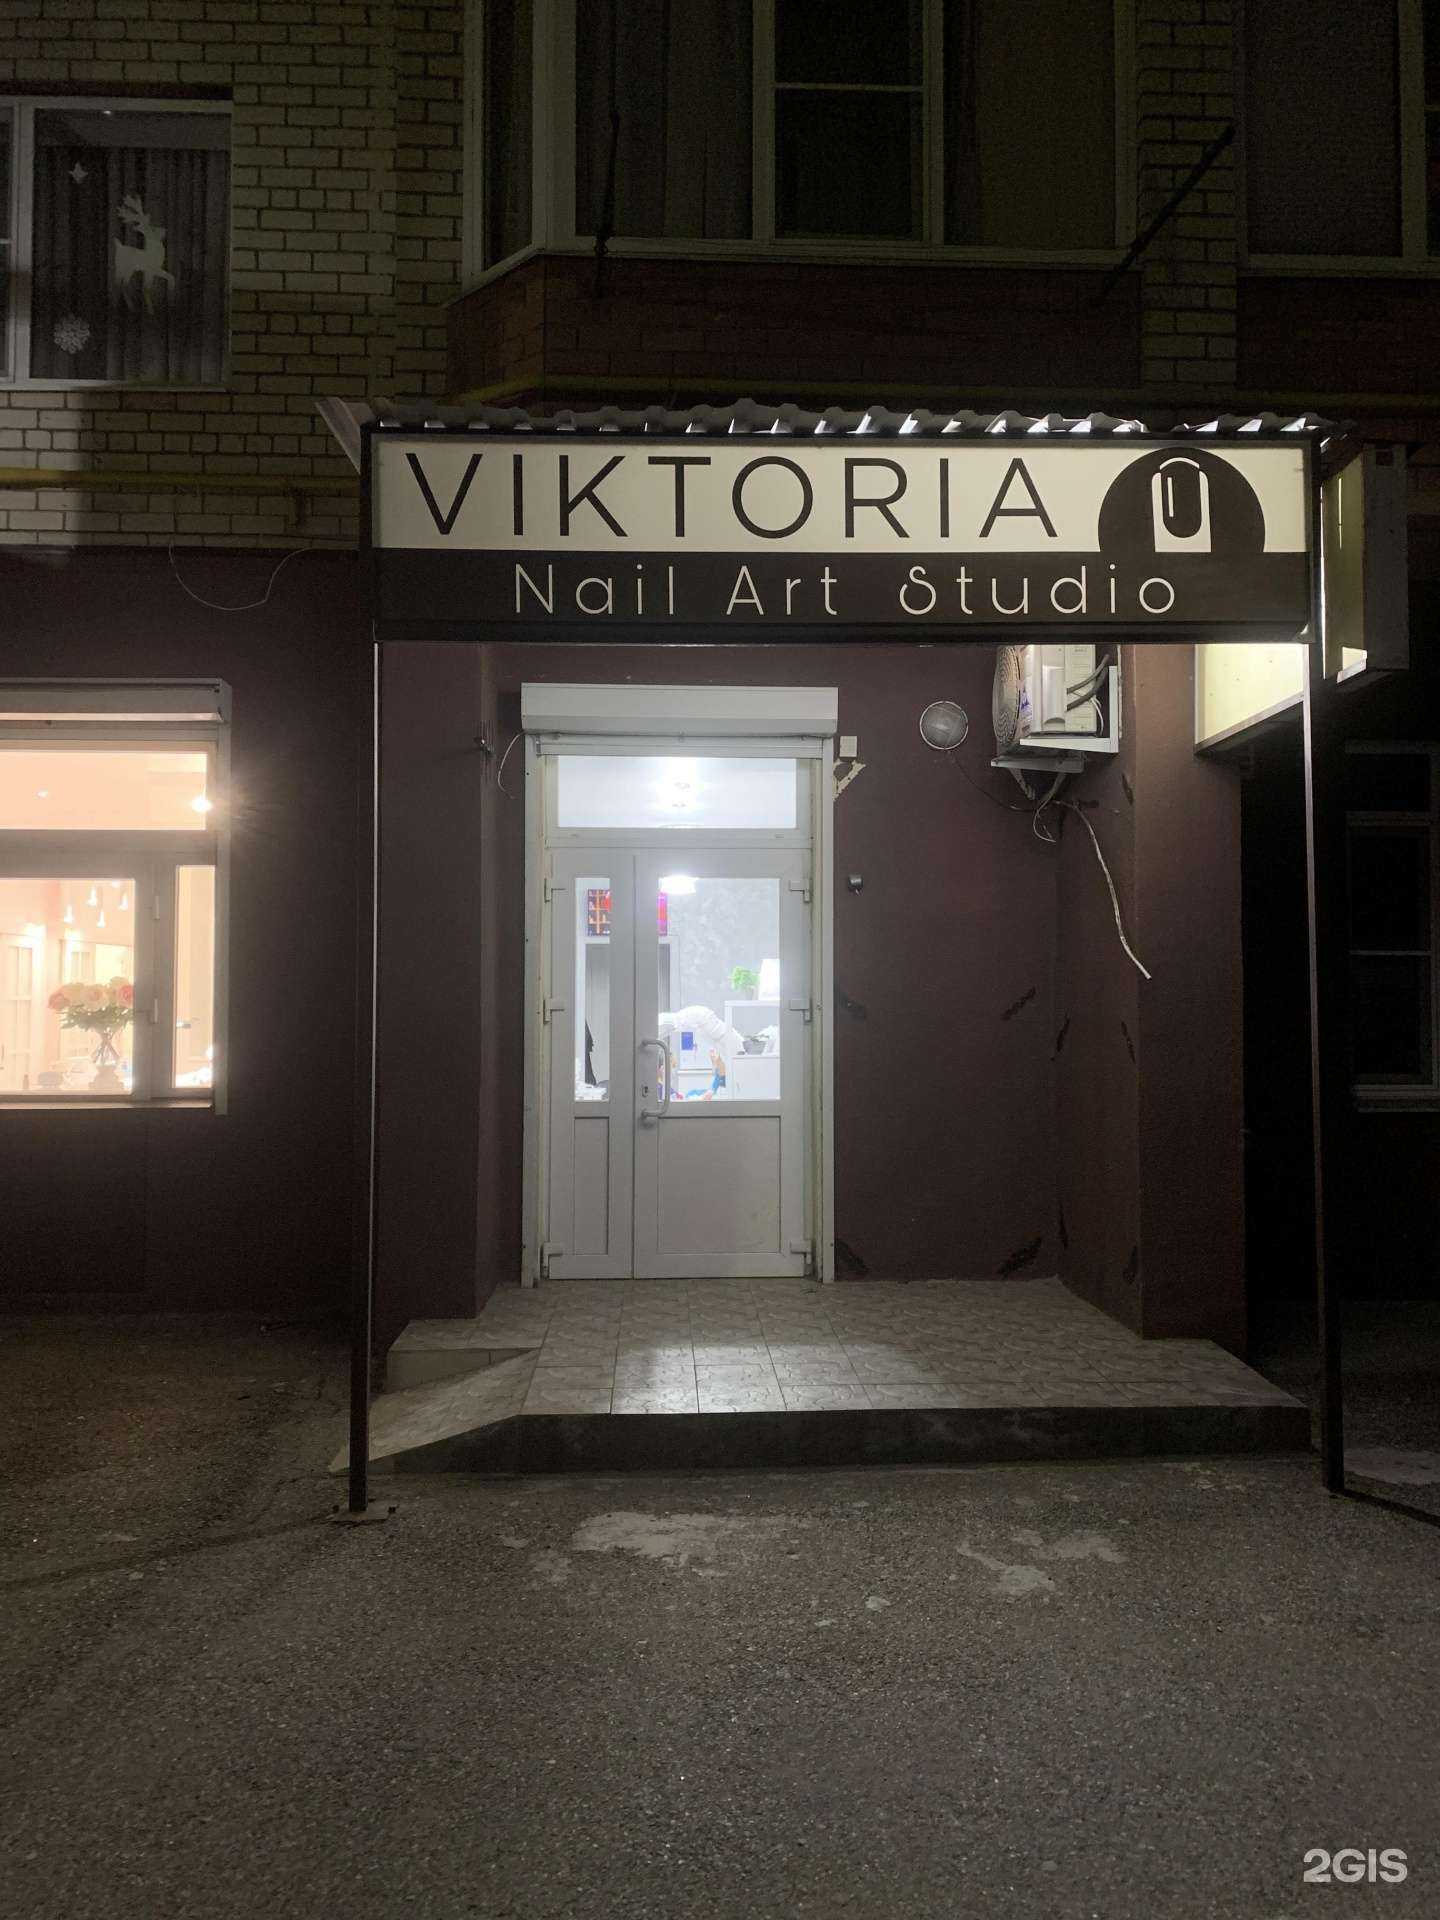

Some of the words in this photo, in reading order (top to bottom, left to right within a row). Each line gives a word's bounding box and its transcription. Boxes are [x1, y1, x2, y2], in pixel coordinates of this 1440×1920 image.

[406, 453, 1058, 538] VIKTORIA
[514, 563, 675, 615] Nail
[726, 565, 838, 616] Art
[898, 565, 1175, 616] Studio
